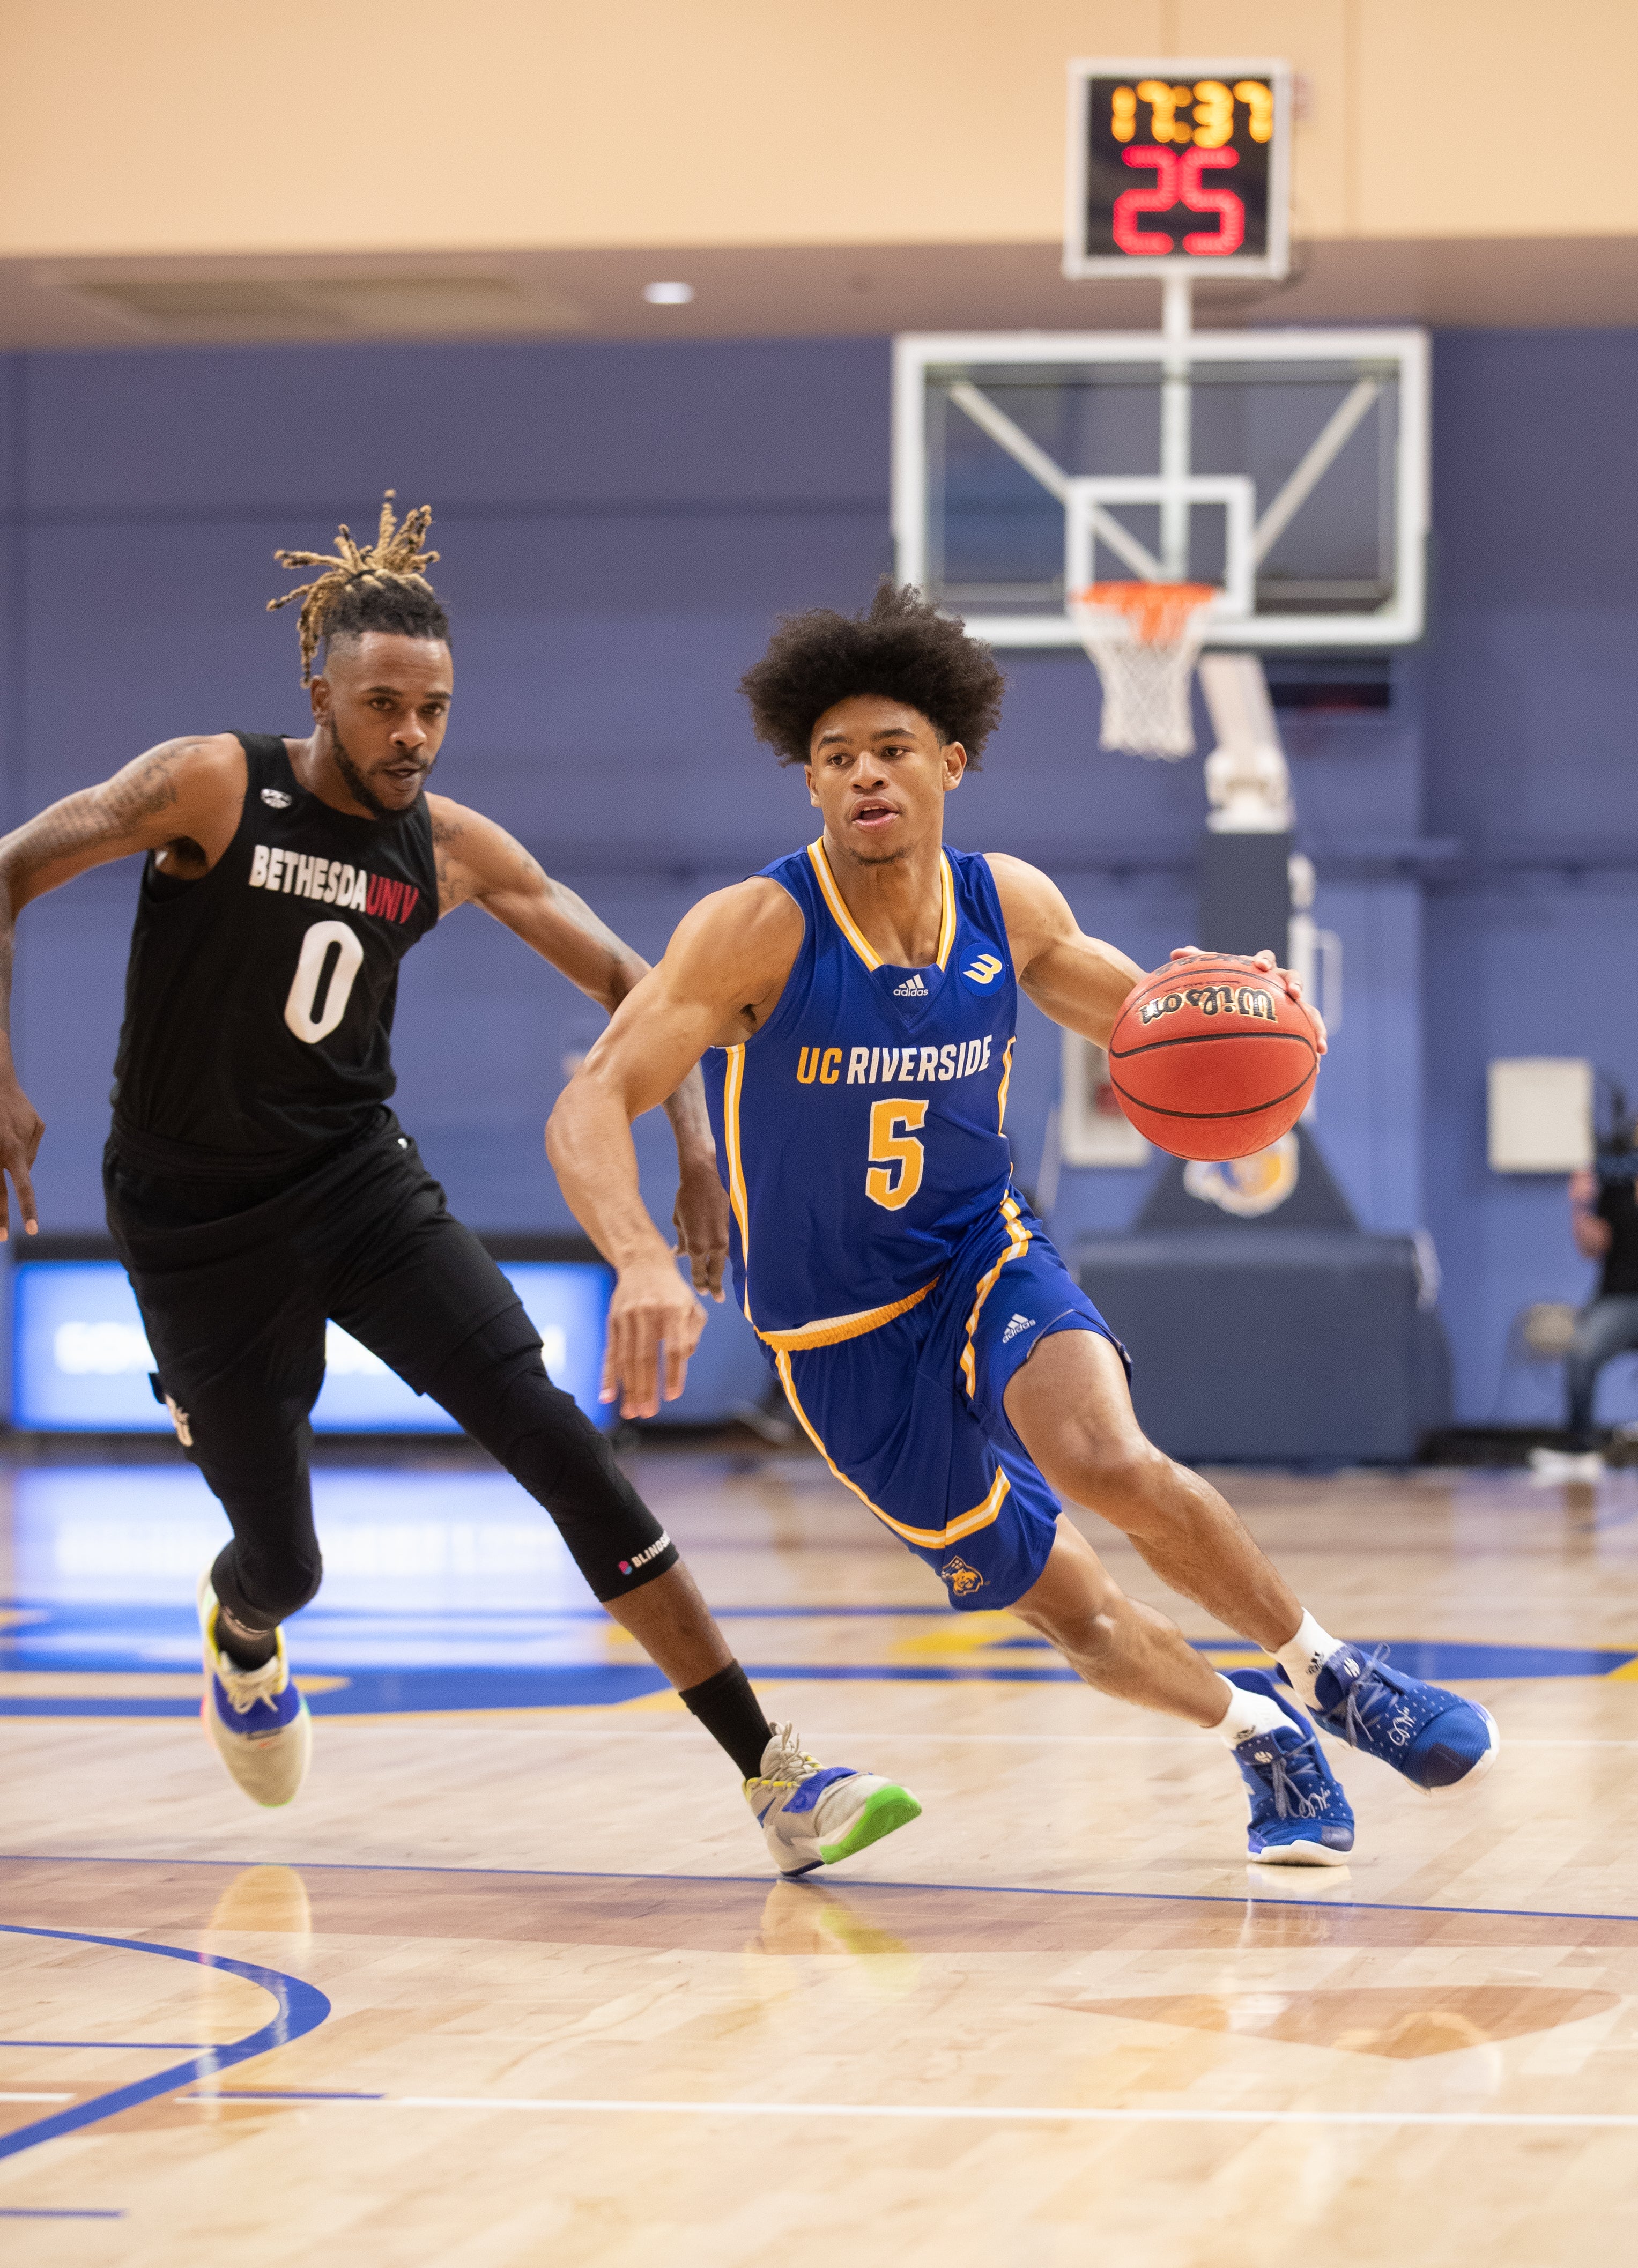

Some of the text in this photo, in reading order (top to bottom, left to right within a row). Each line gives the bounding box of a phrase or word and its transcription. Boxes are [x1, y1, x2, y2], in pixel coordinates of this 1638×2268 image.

[1111, 80, 1273, 148] 17:37
[1113, 145, 1244, 255] 25
[284, 920, 364, 1044] 0
[893, 988, 929, 997] adidas
[1138, 984, 1279, 1026] Wilson
[796, 1034, 992, 1084] UC RIVERSIDE
[865, 1098, 929, 1211] 5
[1002, 1319, 1036, 1344] adidas
